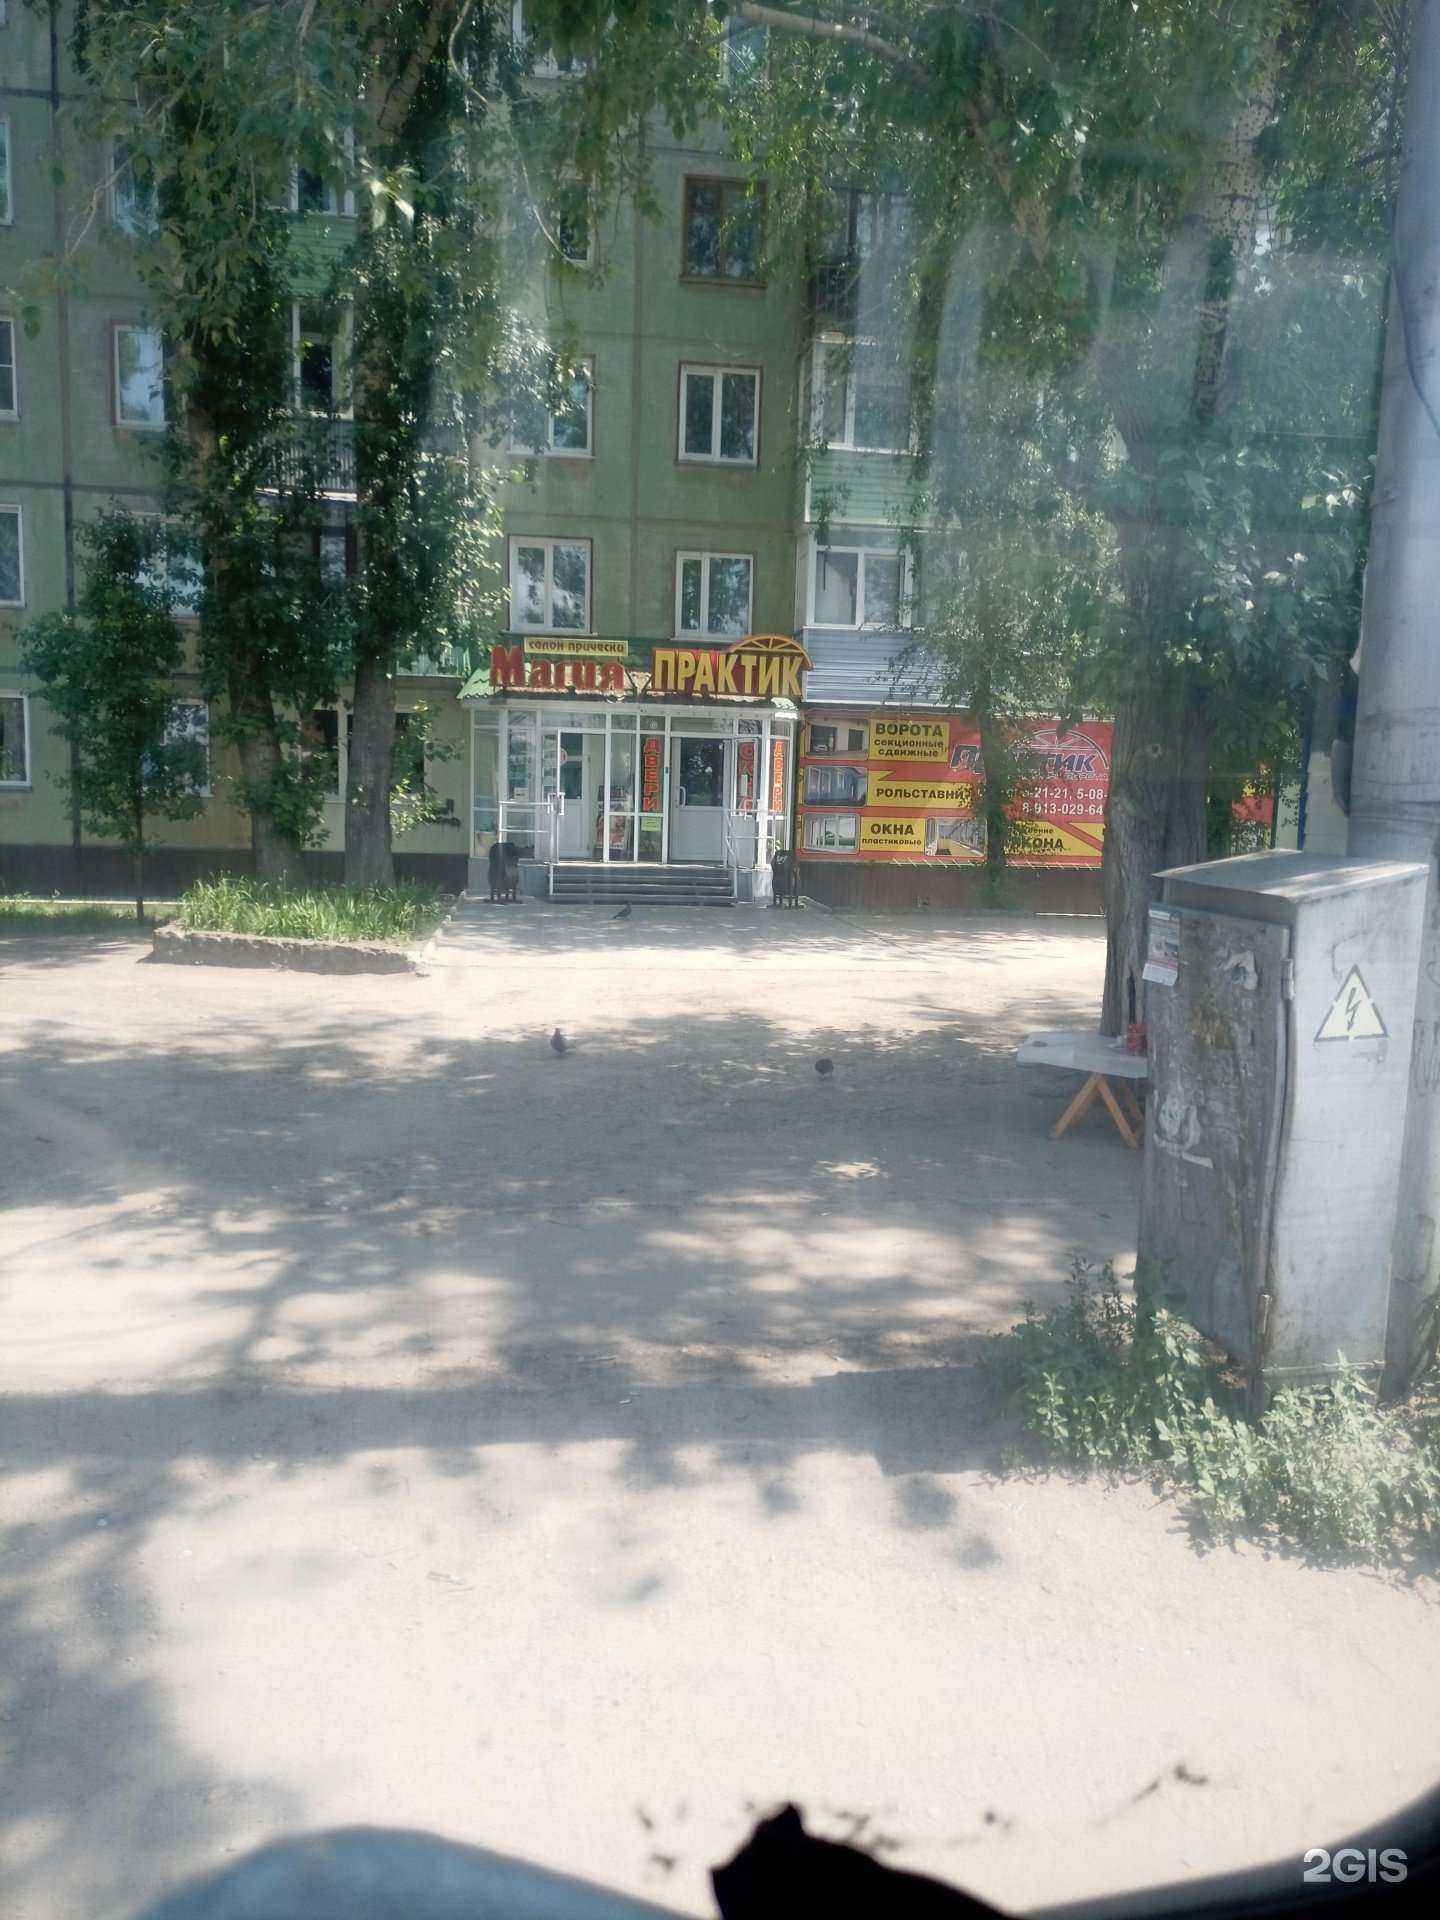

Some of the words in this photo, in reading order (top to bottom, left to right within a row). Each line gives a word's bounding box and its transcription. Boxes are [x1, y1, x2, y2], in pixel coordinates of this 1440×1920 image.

[529, 641, 564, 650] салон
[568, 642, 624, 653] прически
[490, 645, 625, 691] Магия
[655, 650, 802, 695] ПРАКТИК
[876, 723, 943, 736] ВОРОТА
[874, 739, 944, 748] секционные
[878, 749, 938, 757] сдвижные
[643, 737, 661, 811] ДВЕРИ
[773, 741, 785, 813] ДВЕРИ
[870, 823, 914, 835] ОКНА
